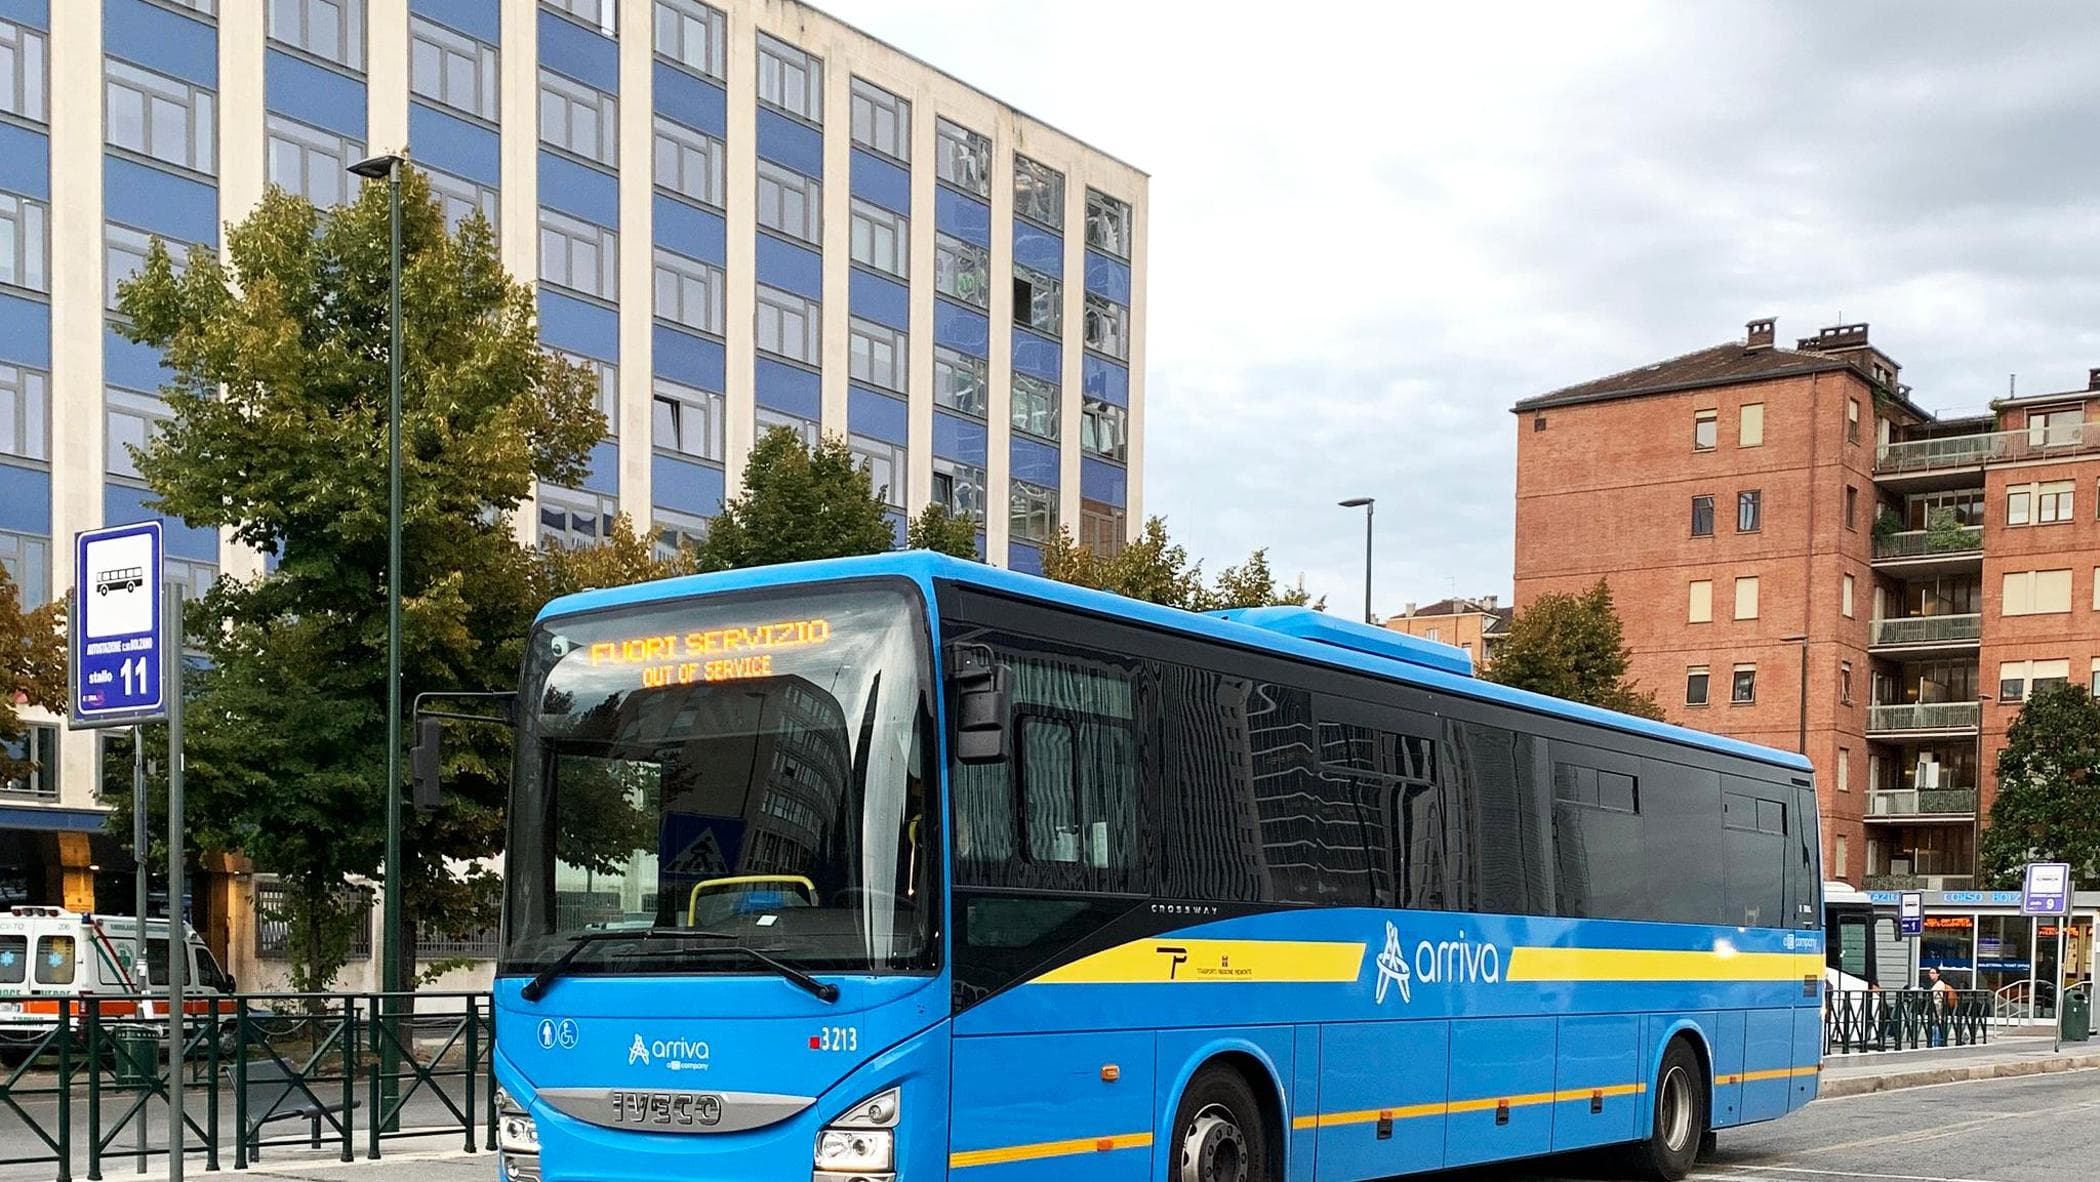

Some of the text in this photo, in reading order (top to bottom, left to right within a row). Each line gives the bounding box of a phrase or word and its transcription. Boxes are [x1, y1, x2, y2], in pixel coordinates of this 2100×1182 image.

[591, 619, 829, 666] FUORI SERVIZIO
[88, 656, 147, 696] stallo 11
[642, 655, 772, 687] OUT OF SERVICE
[1151, 904, 1218, 915] CROSSWAY
[2046, 898, 2055, 910] 9
[1911, 921, 1916, 931] 1
[1415, 929, 1499, 984] arriva
[652, 1037, 709, 1059] arriva
[822, 1027, 857, 1051] 3213
[613, 1091, 722, 1126] IVECO
